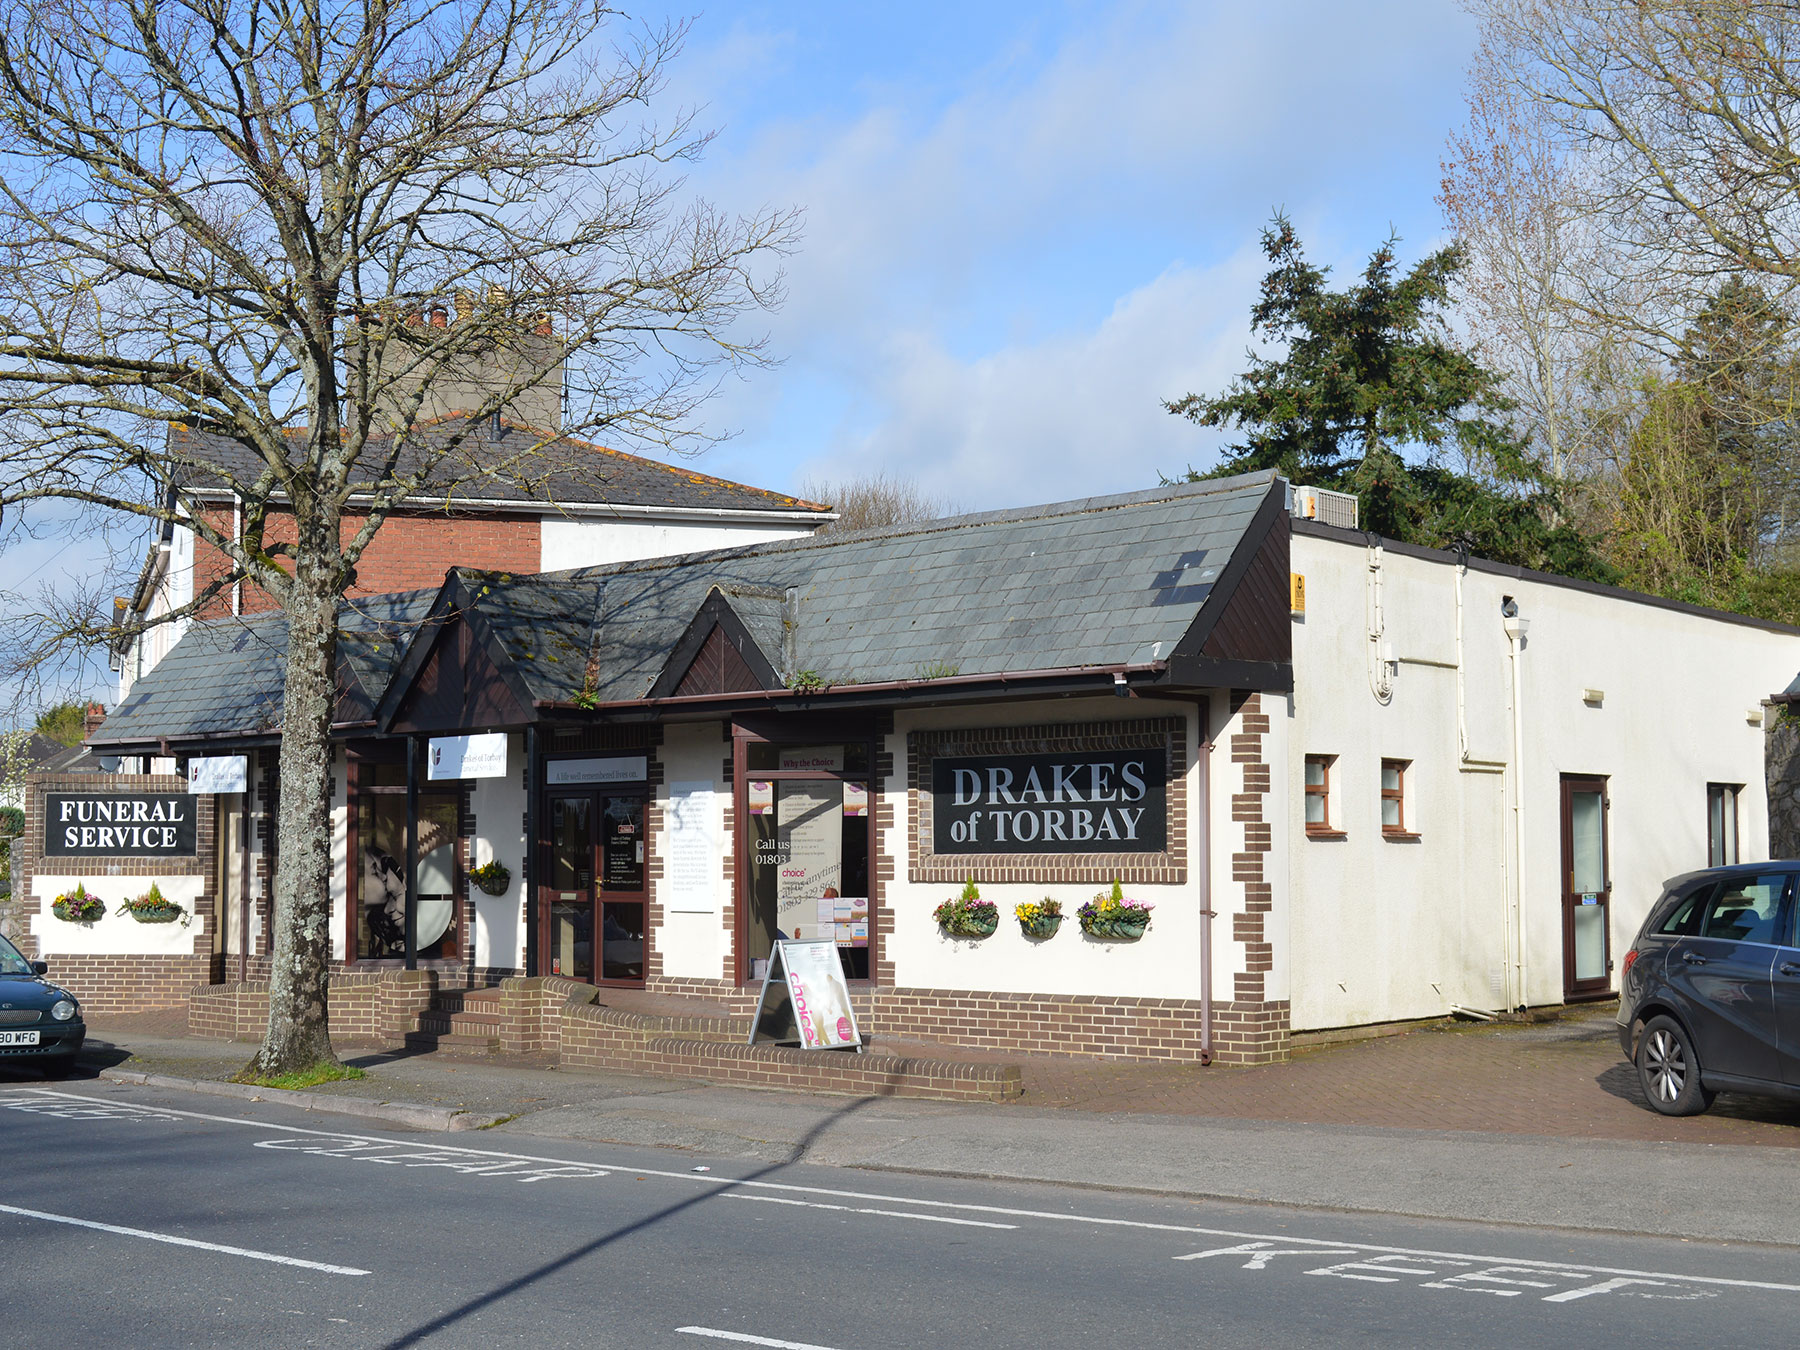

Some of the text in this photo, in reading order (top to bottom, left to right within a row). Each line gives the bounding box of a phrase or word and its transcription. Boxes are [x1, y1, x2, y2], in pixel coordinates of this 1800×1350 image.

[784, 758, 834, 769] Why the Choice
[951, 761, 1147, 806] DRAKES
[59, 800, 184, 822] FUNERAL
[950, 807, 1146, 843] of TORBAY
[64, 825, 178, 848] SERVICE
[755, 839, 775, 850] Call
[778, 842, 790, 850] us
[755, 855, 787, 865] 01803
[806, 862, 841, 884] anytime
[790, 972, 815, 1041] choice
[15, 1033, 35, 1043] WFG
[252, 1138, 611, 1182] CLEAR
[1171, 1242, 1723, 1302] KEEP
